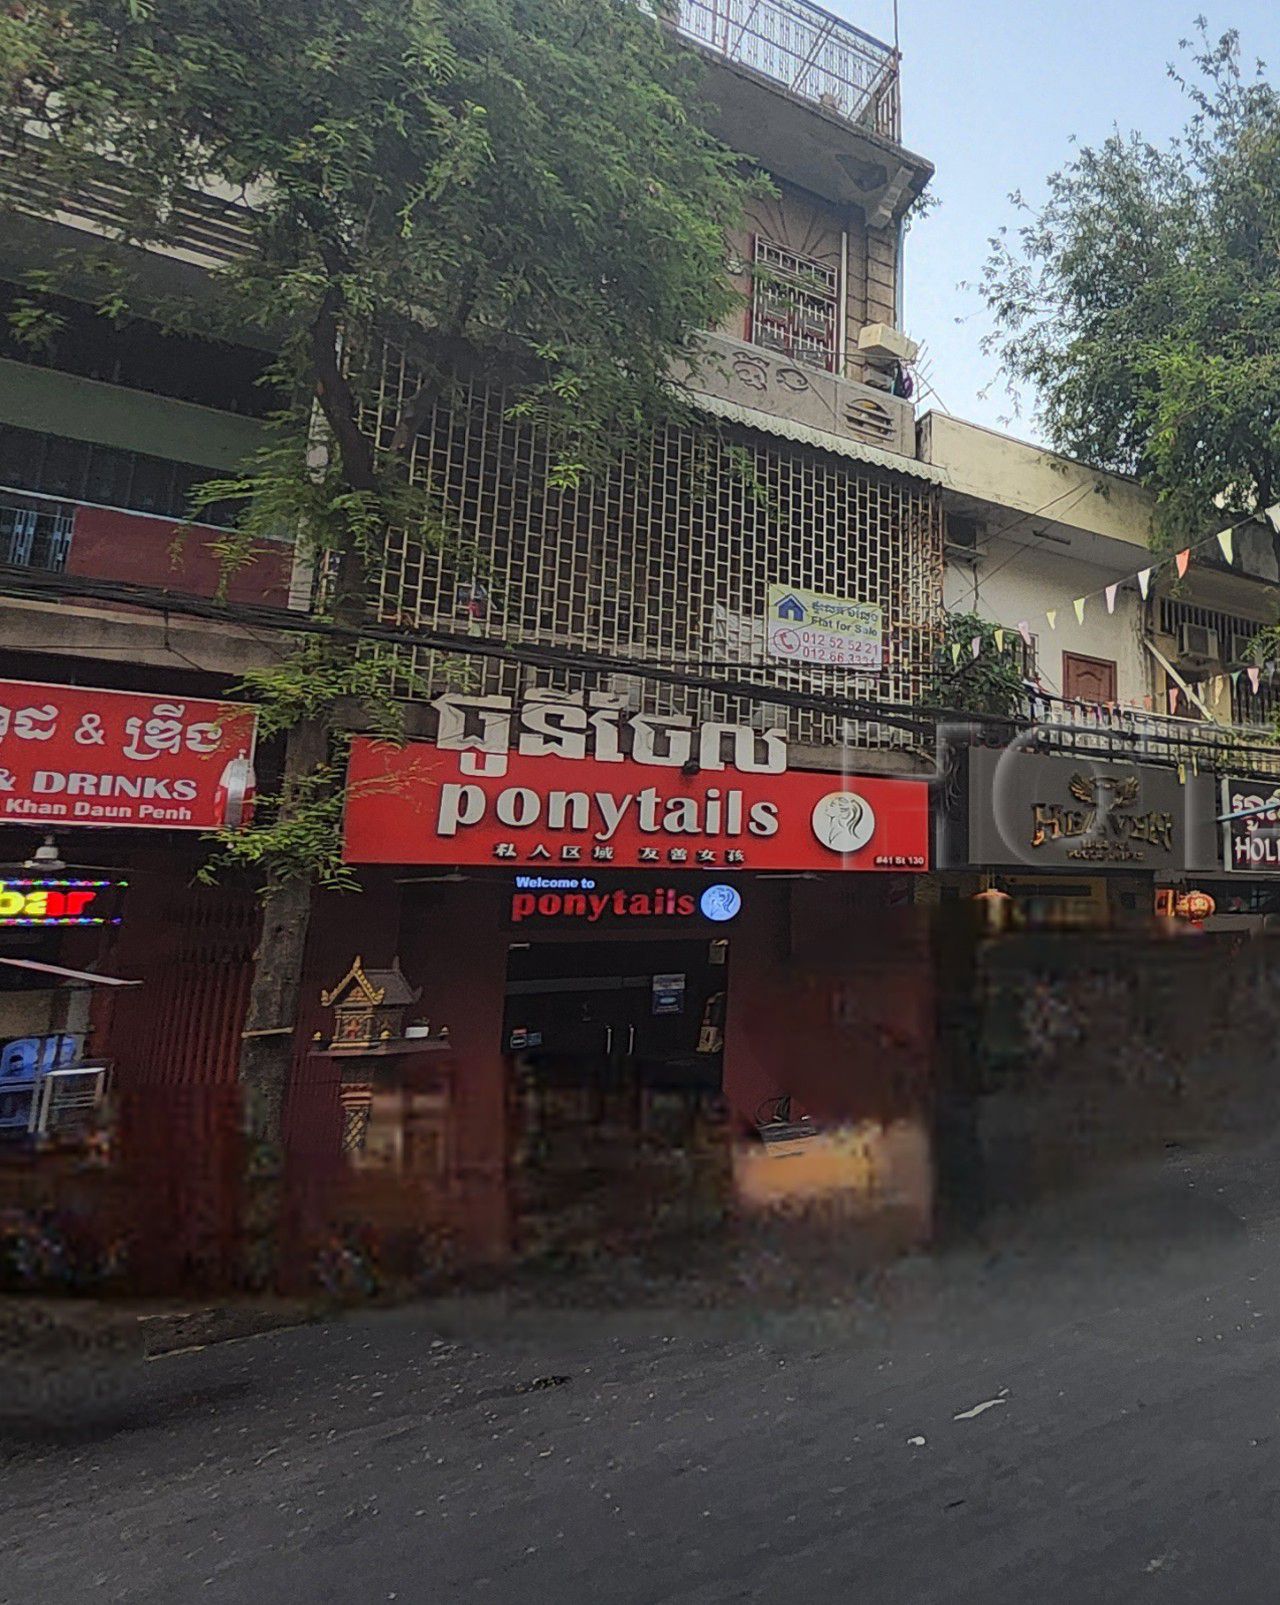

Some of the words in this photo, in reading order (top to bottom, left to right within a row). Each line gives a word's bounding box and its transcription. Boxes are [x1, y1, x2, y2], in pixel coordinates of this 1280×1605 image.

[812, 616, 832, 628] Flat
[836, 621, 851, 631] for
[803, 632, 824, 645] 012
[74, 713, 105, 745] &
[32, 771, 197, 800] DRINKS
[6, 799, 67, 815] Khan
[74, 802, 131, 817] Daun
[139, 805, 191, 820] Penh
[437, 783, 779, 840] ponytails
[495, 843, 614, 860] 私人区域
[908, 856, 924, 865] 130
[515, 876, 578, 889] Welcome
[581, 878, 595, 889] to
[512, 888, 696, 921] ponytails
